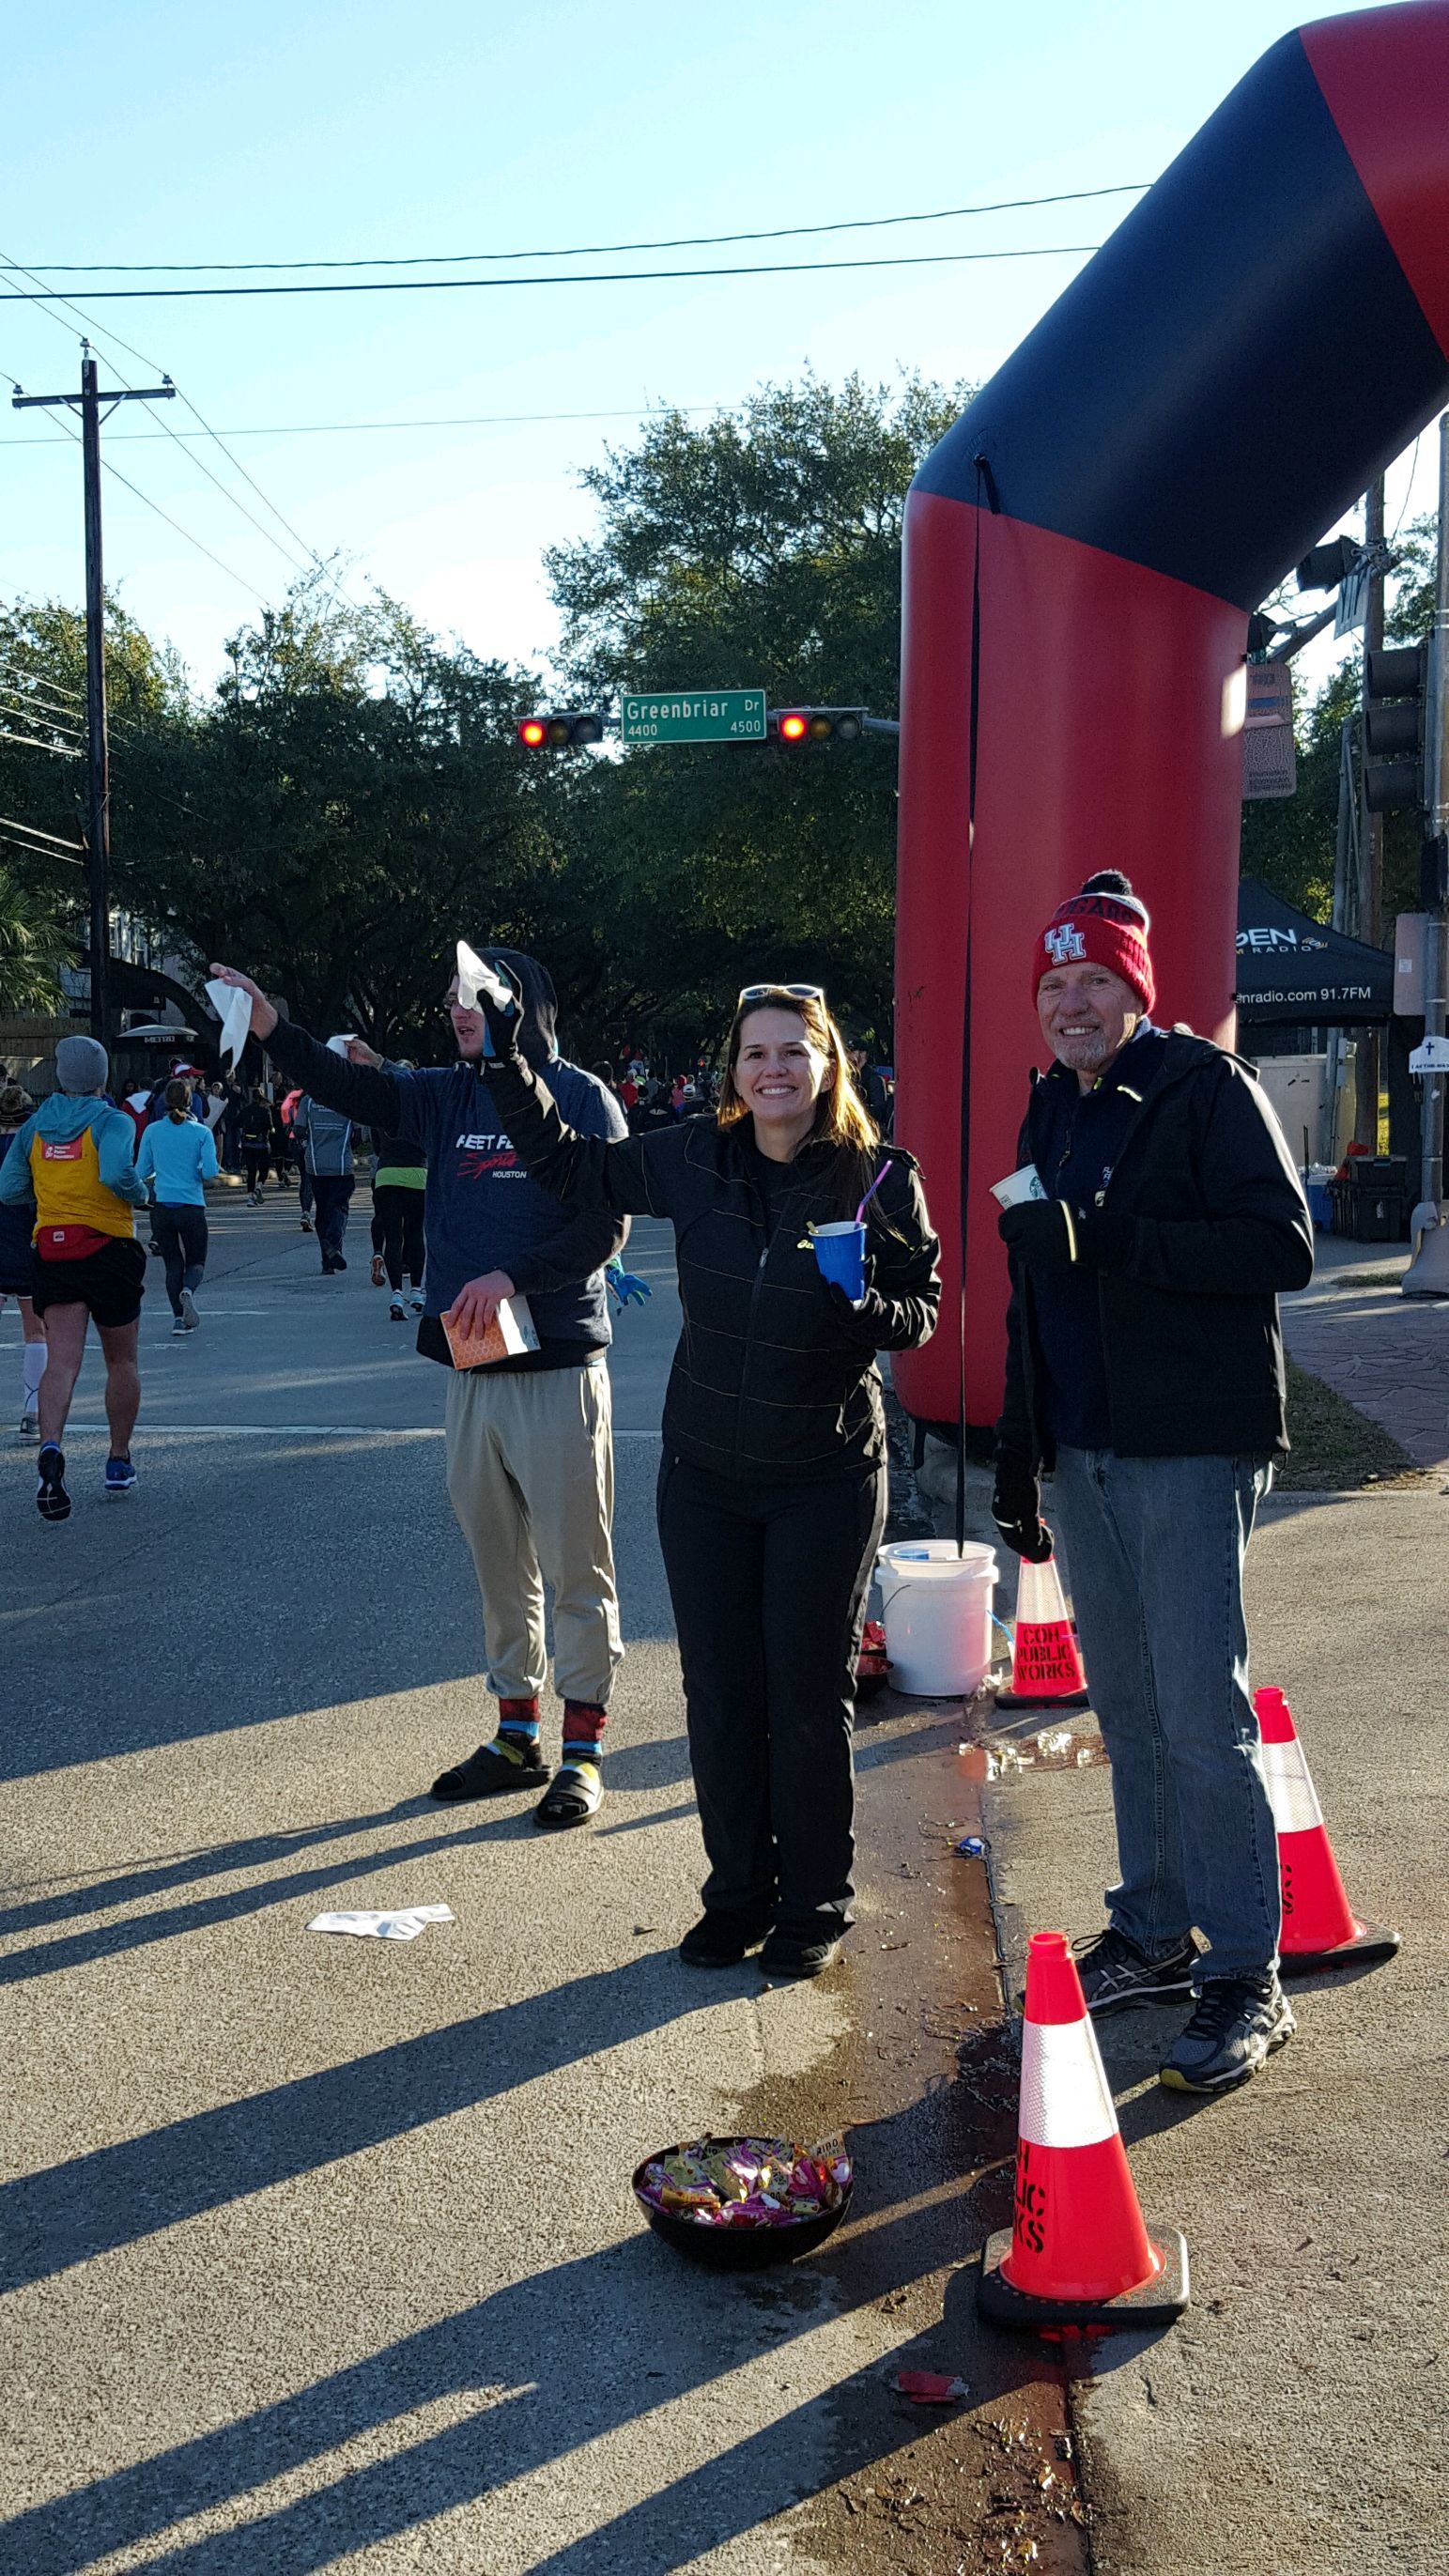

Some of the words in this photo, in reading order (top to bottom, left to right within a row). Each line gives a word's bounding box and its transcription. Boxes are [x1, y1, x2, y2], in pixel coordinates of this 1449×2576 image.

[626, 700, 728, 720] Greenbriar
[745, 700, 760, 711] Dr
[628, 724, 657, 736] 4400
[731, 720, 761, 733] 4500
[1253, 946, 1312, 954] RADIO
[1320, 986, 1371, 1000] 91.7FM
[492, 1170, 528, 1179] HOUSTON
[1023, 1626, 1060, 1644] COH
[1016, 1645, 1071, 1663] PUBLIC
[1017, 1662, 1076, 1681] WORKS
